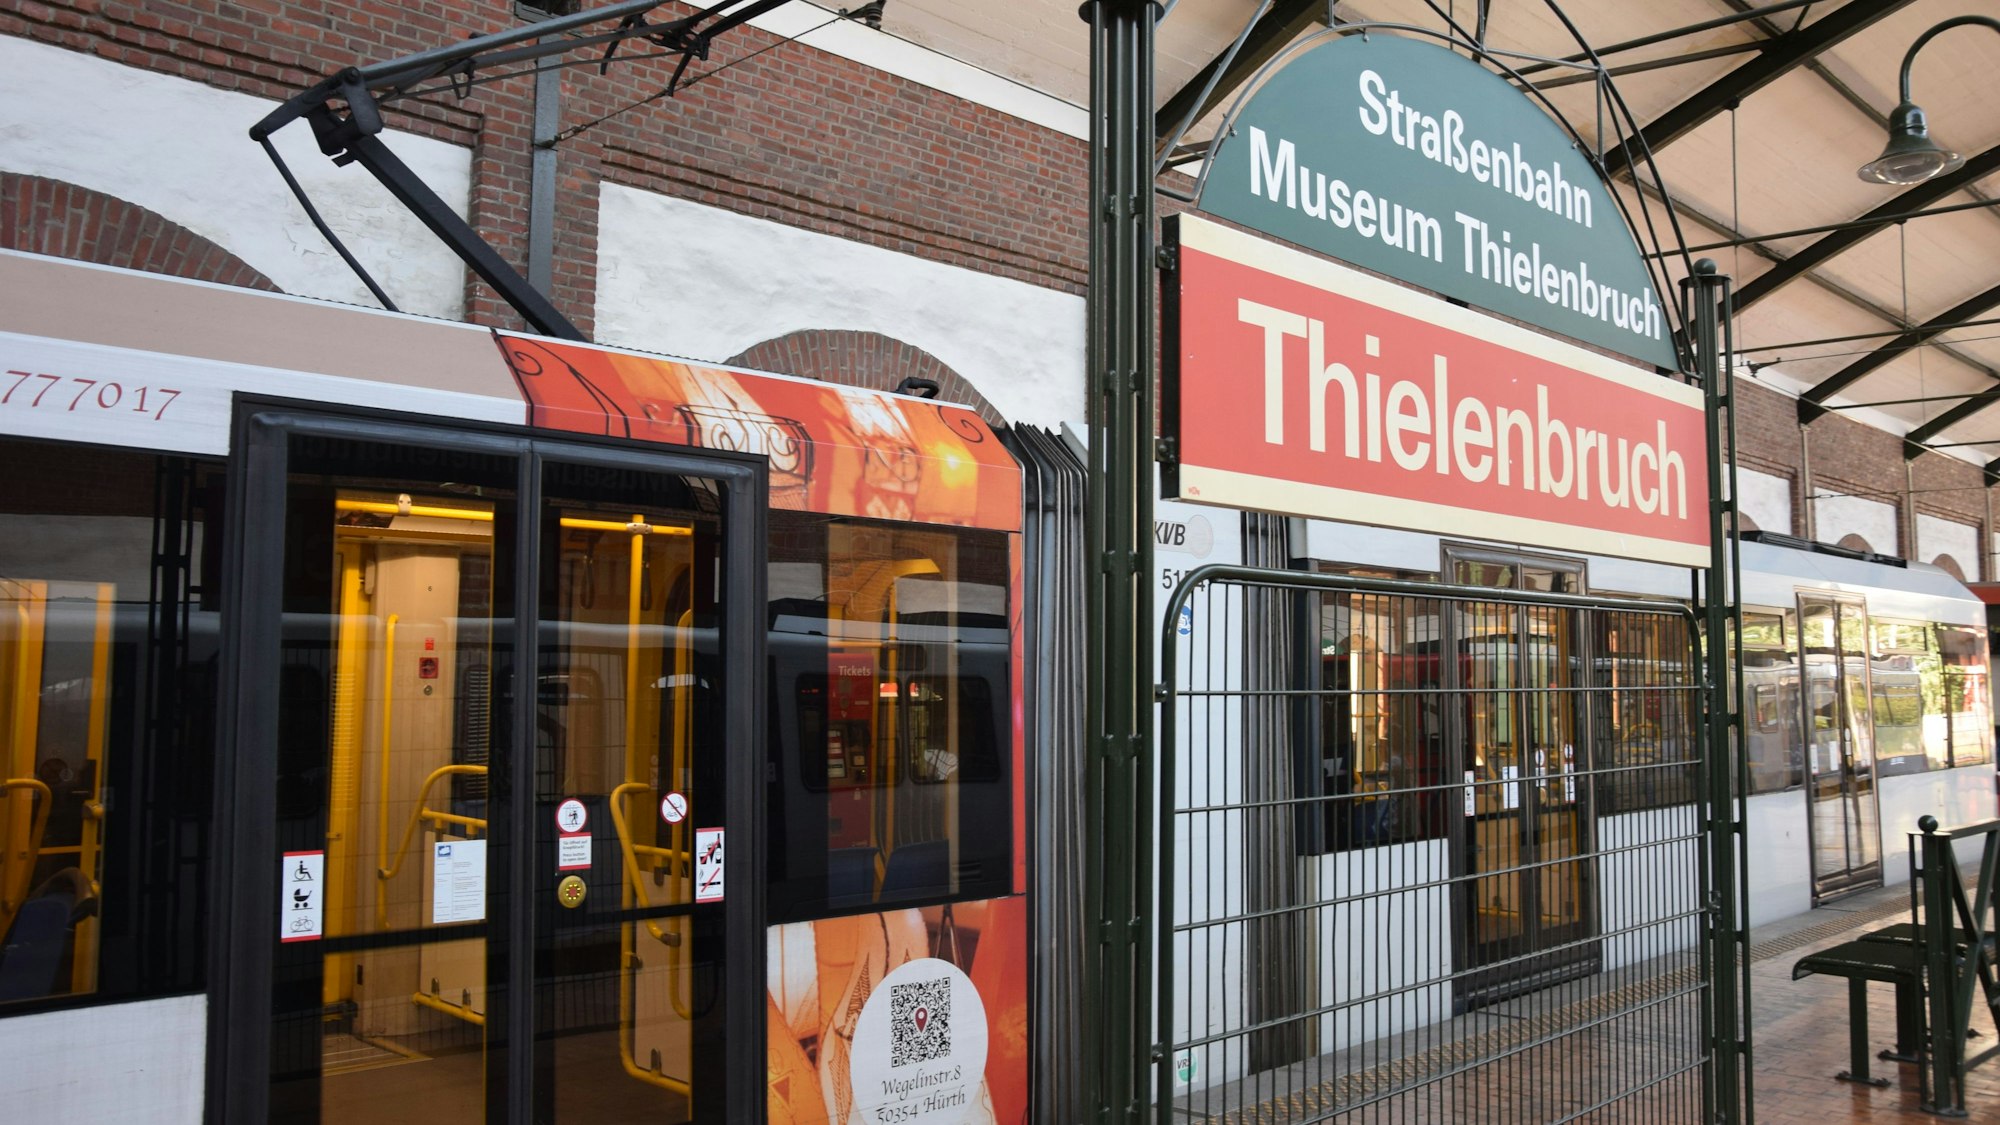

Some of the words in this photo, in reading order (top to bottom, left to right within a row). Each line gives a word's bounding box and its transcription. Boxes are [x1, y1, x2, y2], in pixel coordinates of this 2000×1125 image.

[1359, 69, 1592, 228] Straßenbahn
[1249, 125, 1443, 262] Museum
[1455, 211, 1661, 340] Thielenbruch
[1237, 297, 1687, 520] Thielenbruch
[1154, 521, 1186, 546] KVB
[838, 666, 871, 676] Tickets
[882, 1065, 961, 1100] Wegelinstr.8
[876, 1103, 918, 1125] 50354
[924, 1085, 965, 1112] Hürth
